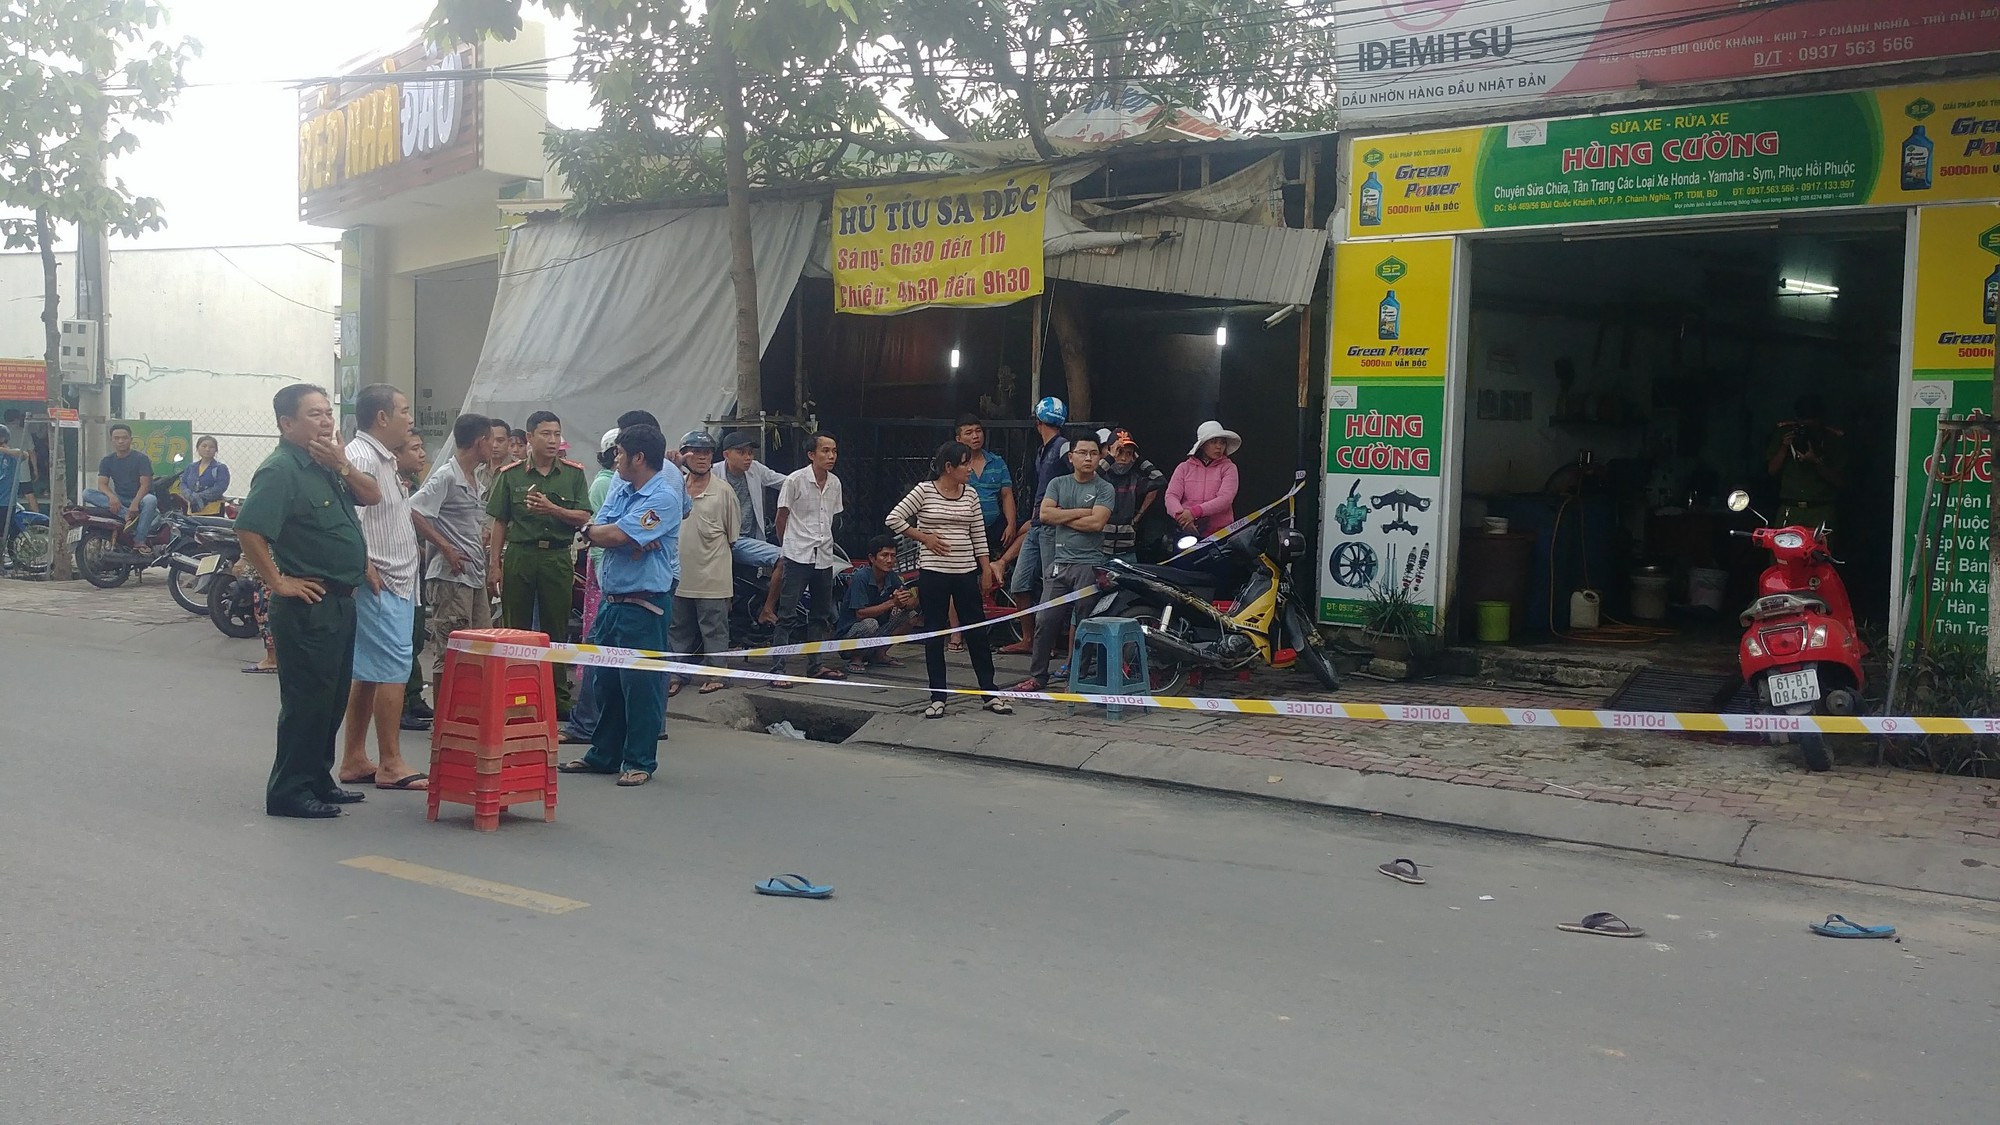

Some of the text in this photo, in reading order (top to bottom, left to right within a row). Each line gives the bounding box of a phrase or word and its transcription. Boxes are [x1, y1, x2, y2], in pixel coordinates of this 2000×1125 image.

[1801, 30, 1808, 39] 7
[1359, 25, 1513, 72] IDEMITSU
[1753, 36, 1914, 67] Đ/T 0937 563 566
[1342, 72, 1546, 107] DẦU NHỜN HÀNG ĐẦU NHẬT BẢN
[1610, 112, 1730, 135] SỬA XE RỬA XE
[1562, 130, 1779, 174] HÙNG CƯỜNG
[1395, 164, 1451, 180] Green
[1940, 164, 1988, 177] 5000km
[1494, 159, 1856, 200] Chuyên Sửa Chữa, Tân Trang Các Loại Xe Honda Yamaha Sym, Phục Hồi Phuộc
[1404, 182, 1461, 198] Power
[1706, 189, 1718, 198] BD
[1747, 184, 1795, 196] 0937.563.566
[1801, 179, 1856, 192] 0917.133.997
[838, 178, 1040, 236] HỦ TÍU SA ĐÉC
[1387, 204, 1422, 215] 5000km
[837, 230, 1007, 271] Sáng: 6h30 đến 11h
[1382, 264, 1401, 274] SP
[839, 265, 1030, 309] Chiều: 4h30 đến 9h30
[1938, 331, 1995, 345] Green
[1347, 345, 1430, 357] Green Power
[1958, 347, 1994, 358] 5000k
[1360, 359, 1393, 368] 5000km
[1345, 409, 1423, 439] HÙNG
[1336, 442, 1430, 471] CƯỜNG
[1943, 514, 1990, 533] Phuộc
[1957, 535, 1975, 551] Vỏ
[1979, 536, 1990, 551] K
[1947, 598, 1976, 614] Hàn
[1935, 618, 1962, 634] Tân
[606, 647, 635, 657] POLICE
[1776, 673, 1809, 690] 61-B1
[1101, 695, 1144, 705] POLICE
[1774, 686, 1815, 704] 084.67
[1286, 702, 1333, 715] POLICE
[1402, 706, 1450, 720] POLICE
[1613, 713, 1666, 727] POLICE
[1745, 717, 1800, 731] POLICE
